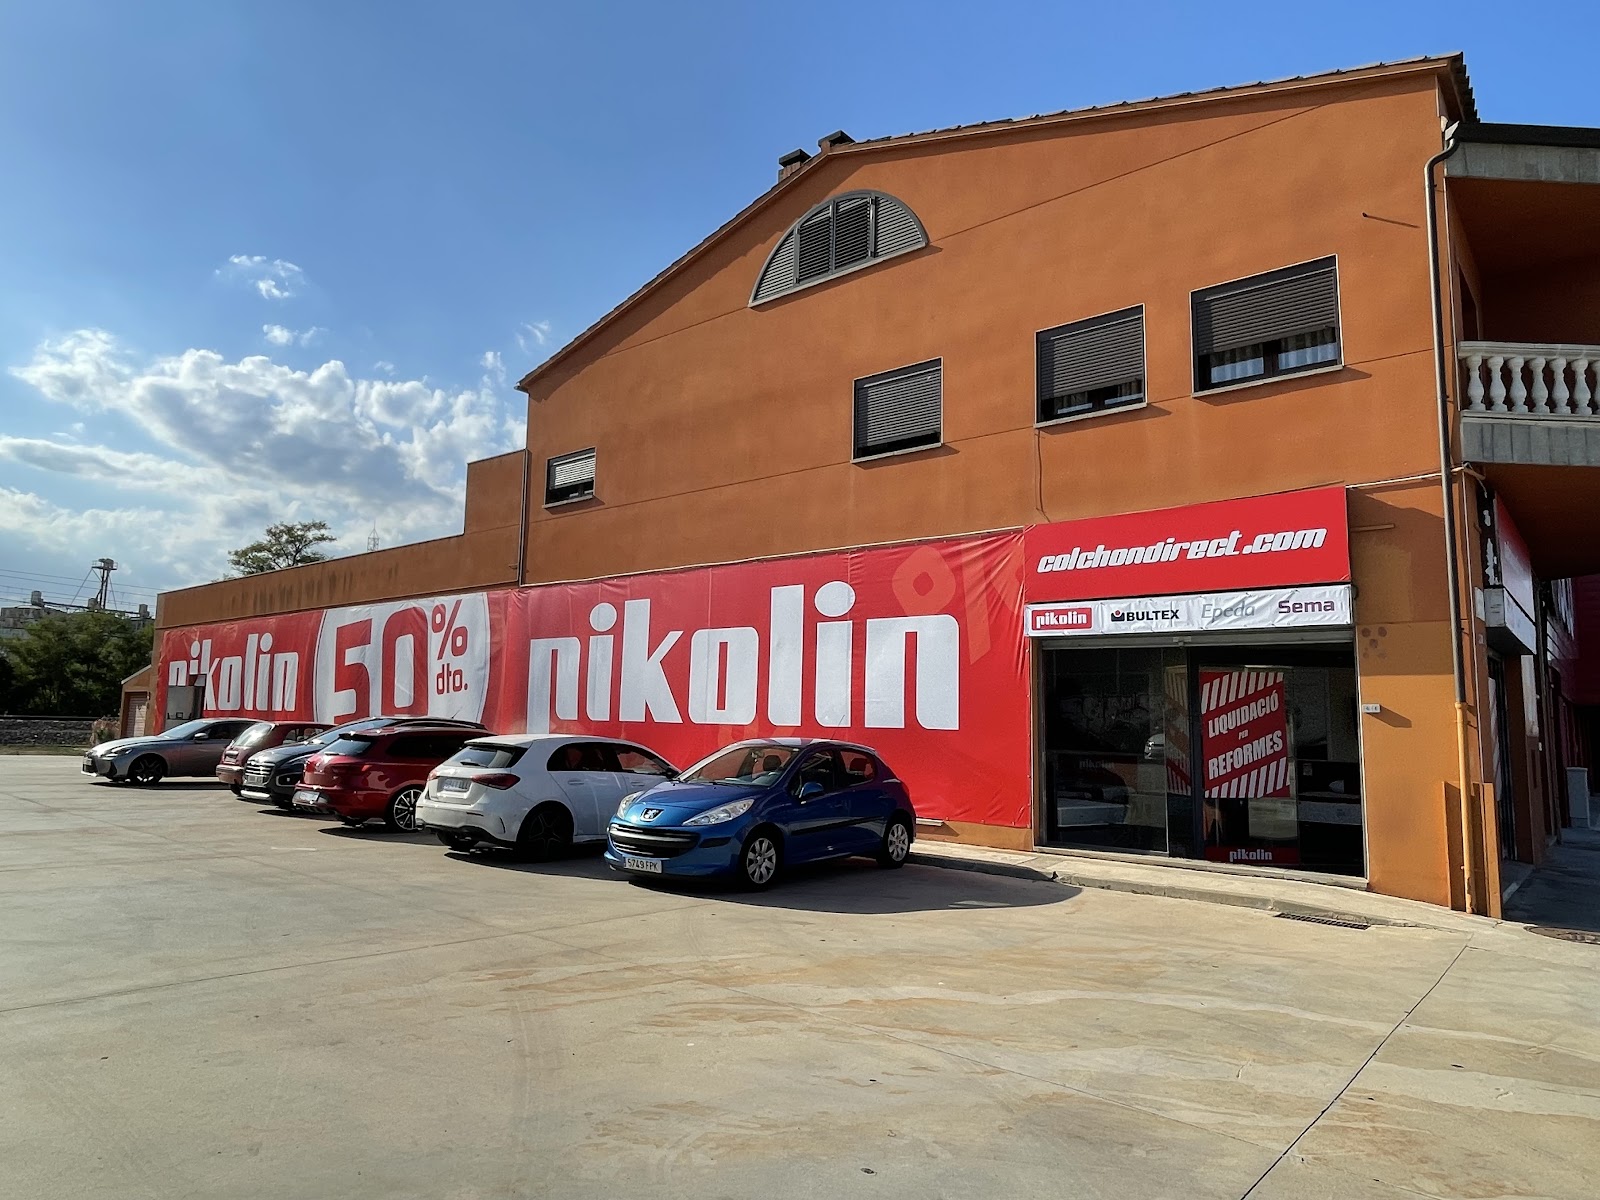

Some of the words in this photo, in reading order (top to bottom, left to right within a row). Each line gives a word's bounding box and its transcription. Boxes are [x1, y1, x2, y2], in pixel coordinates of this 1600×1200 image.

[1036, 528, 1328, 574] colchondirect.com
[1035, 611, 1088, 629] pikolin
[1126, 608, 1180, 622] BULTEX
[1200, 599, 1256, 623] Epeda
[1278, 599, 1335, 614] Sema
[526, 580, 960, 734] pikolin
[436, 662, 469, 695] dto.
[1208, 690, 1279, 738] LIQUIDACIÓ
[1208, 730, 1283, 780] REFORMES
[1229, 848, 1273, 862] pikolin
